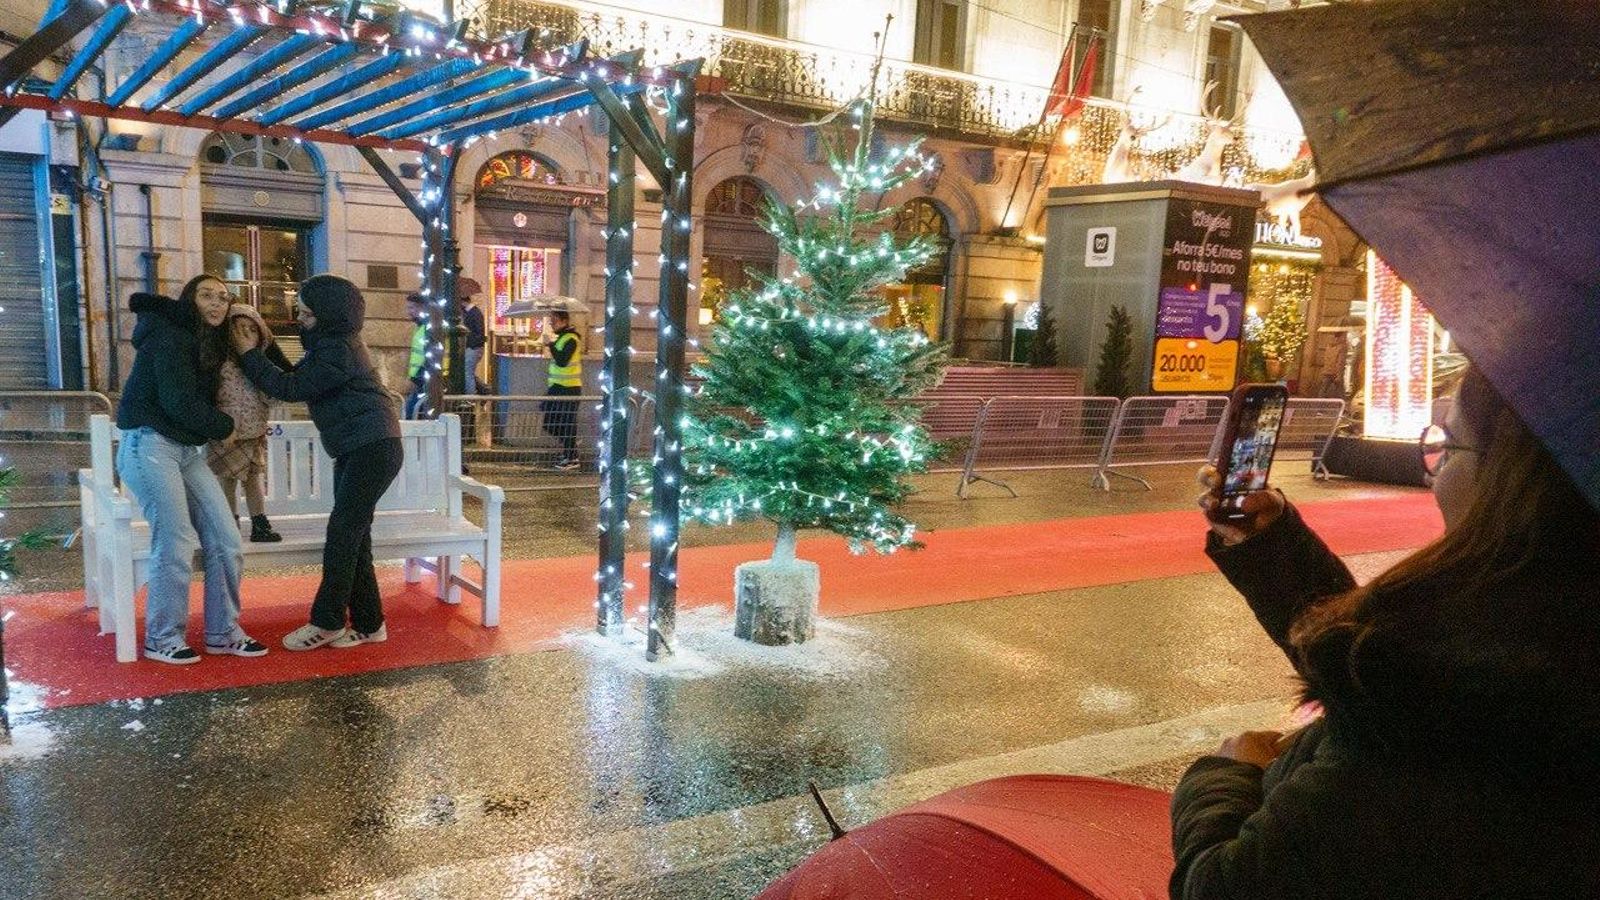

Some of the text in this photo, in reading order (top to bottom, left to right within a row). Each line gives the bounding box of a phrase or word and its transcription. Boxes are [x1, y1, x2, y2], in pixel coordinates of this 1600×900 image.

[1173, 240, 1243, 260] Aforra 5€/mes
[1177, 259, 1235, 275] no teu bono
[1203, 283, 1231, 343] 5
[1160, 354, 1206, 372] 20.000
